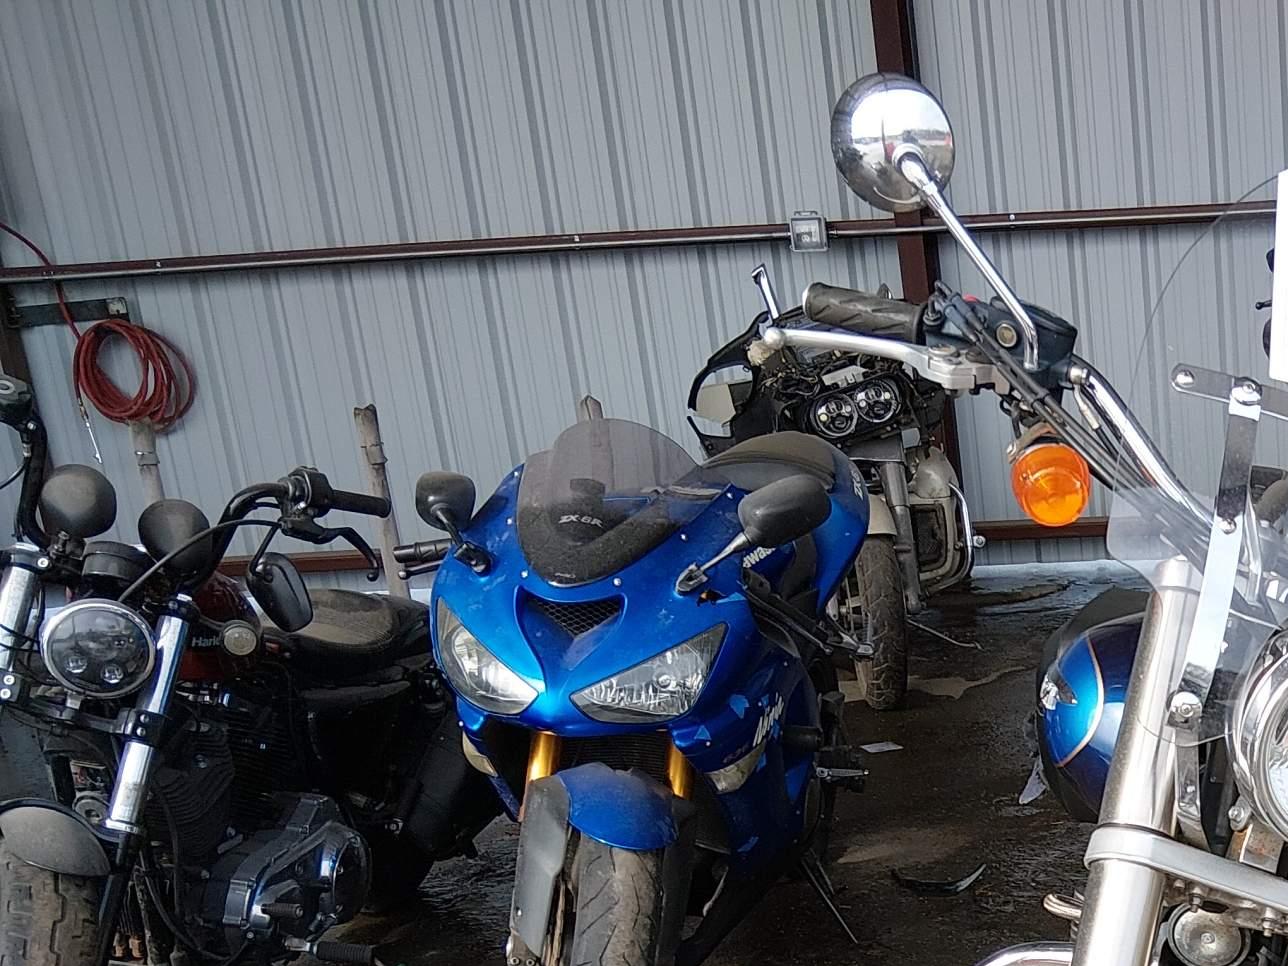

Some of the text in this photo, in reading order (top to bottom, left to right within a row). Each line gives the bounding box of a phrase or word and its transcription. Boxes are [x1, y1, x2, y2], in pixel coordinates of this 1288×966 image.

[743, 546, 776, 568] awas
[191, 635, 221, 648] Harl
[752, 692, 784, 747] Ninja
